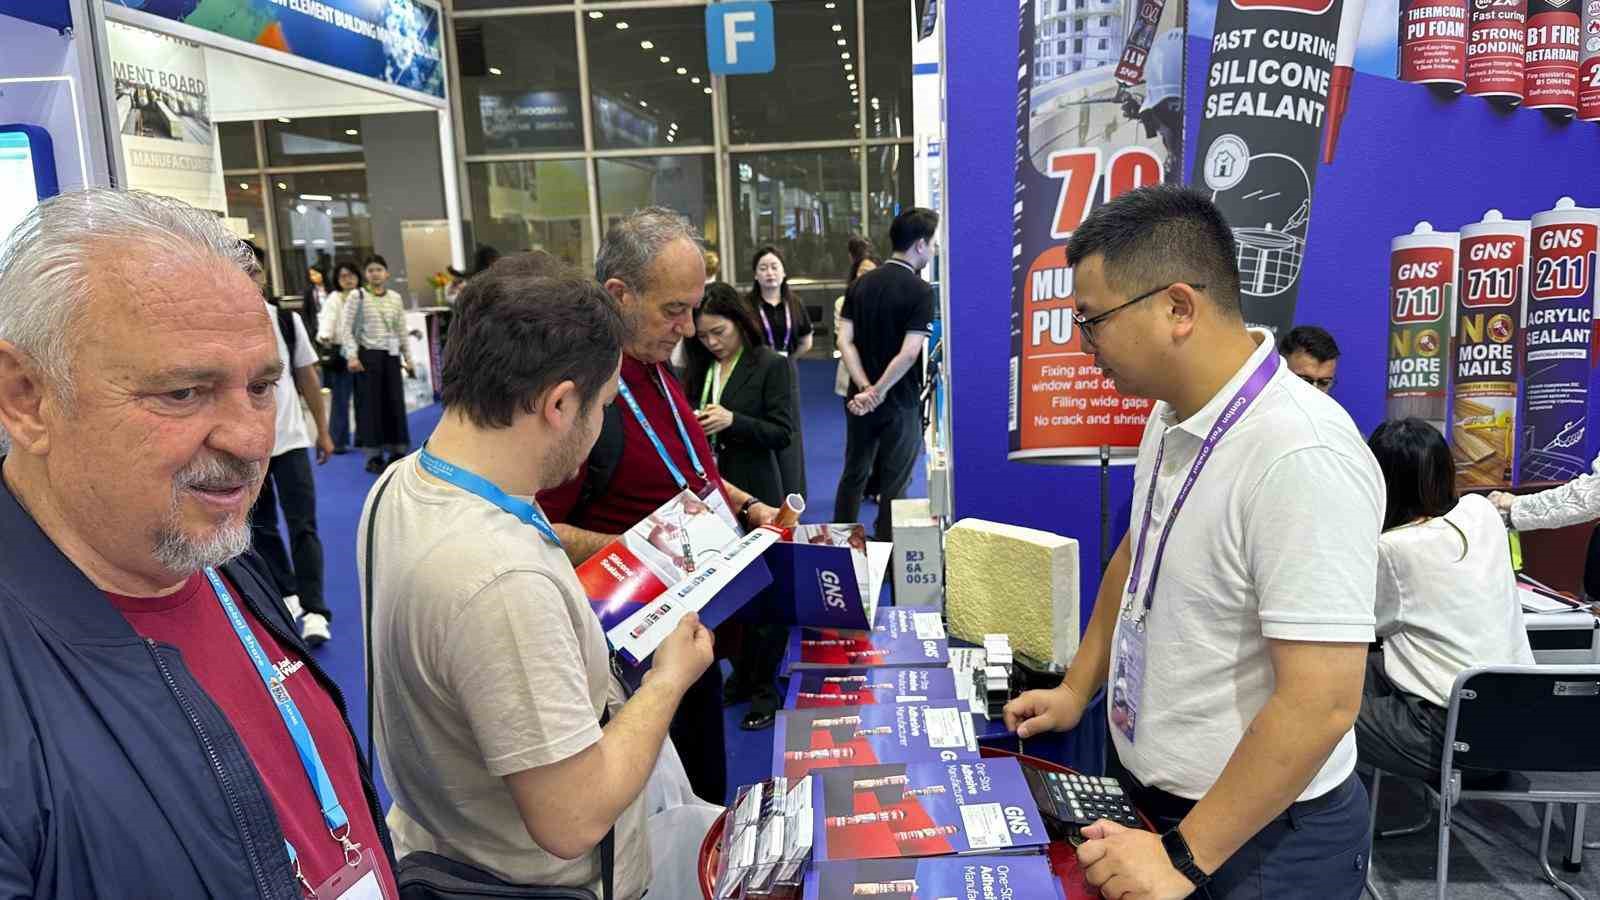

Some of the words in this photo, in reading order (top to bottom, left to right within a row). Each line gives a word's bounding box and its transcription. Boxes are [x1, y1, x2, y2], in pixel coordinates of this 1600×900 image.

[290, 0, 334, 24] ELEMENT
[334, 10, 377, 39] BUILDING
[1407, 6, 1465, 20] THERMCOAT
[1473, 10, 1495, 21] Fast
[1497, 10, 1525, 24] curing
[723, 12, 756, 64] F
[1408, 22, 1426, 40] PU
[1428, 20, 1465, 37] FOAM
[1471, 27, 1524, 42] STRONG
[1527, 26, 1548, 47] B1
[1551, 25, 1580, 46] FIRE
[1212, 28, 1257, 55] FAST
[1263, 28, 1337, 64] CURING
[1468, 41, 1525, 55] BONDING
[1525, 48, 1579, 64] RETARDANT
[159, 71, 206, 97] BOARD
[1209, 58, 1331, 98] SILICONE
[1205, 92, 1326, 128] SEALANT
[1539, 228, 1585, 250] GNS
[1470, 241, 1517, 262] GNS
[1397, 261, 1441, 281] GNS
[1536, 255, 1583, 293] 211
[1032, 267, 1073, 301] MU
[1468, 268, 1513, 300] 711
[1396, 285, 1441, 318] 711
[1032, 307, 1073, 346] PU
[1527, 308, 1592, 326] ACRYLIC
[1526, 328, 1591, 347] SEALANT
[1458, 344, 1513, 361] MORE
[1041, 365, 1075, 378] Fixing
[1389, 357, 1441, 374] MORE
[1458, 360, 1512, 377] NAILS
[1031, 381, 1072, 392] window
[1074, 379, 1098, 390] and
[1388, 373, 1441, 389] NAILS
[1052, 396, 1087, 409] Filling
[1090, 396, 1119, 407] wide
[1122, 397, 1149, 409] gaps
[1222, 396, 1247, 424] Canton
[1034, 415, 1049, 427] No
[1051, 414, 1083, 425] crack
[1086, 414, 1110, 425] and
[1114, 413, 1148, 425] shrink
[1209, 426, 1224, 444] Fair
[906, 563, 922, 573] 6A
[906, 573, 937, 584] 0053
[821, 569, 845, 609] GNS
[221, 592, 245, 630] Global
[244, 633, 265, 667] Share
[923, 640, 939, 659] GNS
[960, 763, 978, 796] Adhesive
[1004, 806, 1032, 836] GNS
